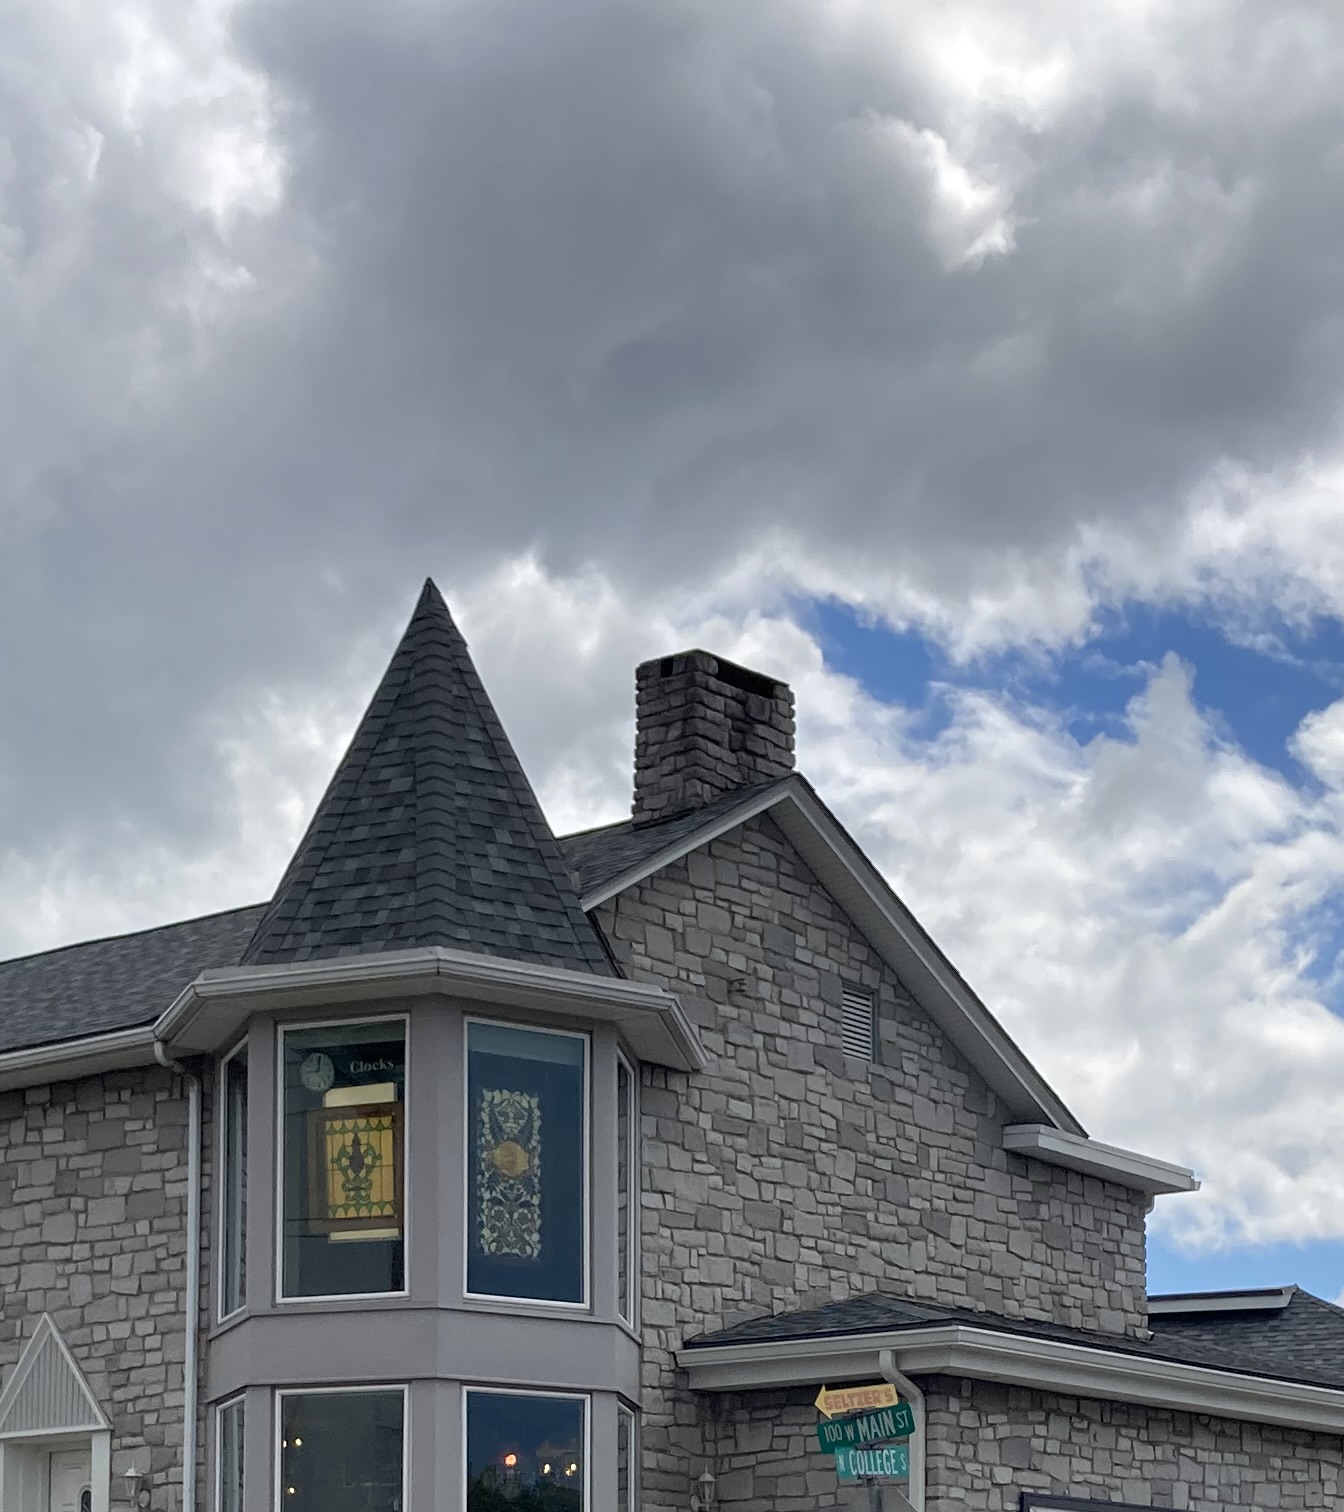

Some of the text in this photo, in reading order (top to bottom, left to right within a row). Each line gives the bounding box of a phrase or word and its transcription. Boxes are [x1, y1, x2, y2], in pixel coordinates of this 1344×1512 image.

[349, 1058, 394, 1074] Clocks
[823, 1387, 894, 1411] SELTZER'S
[823, 1409, 911, 1443] 100 W MAIN ST
[849, 1449, 899, 1475] COLLEGE
